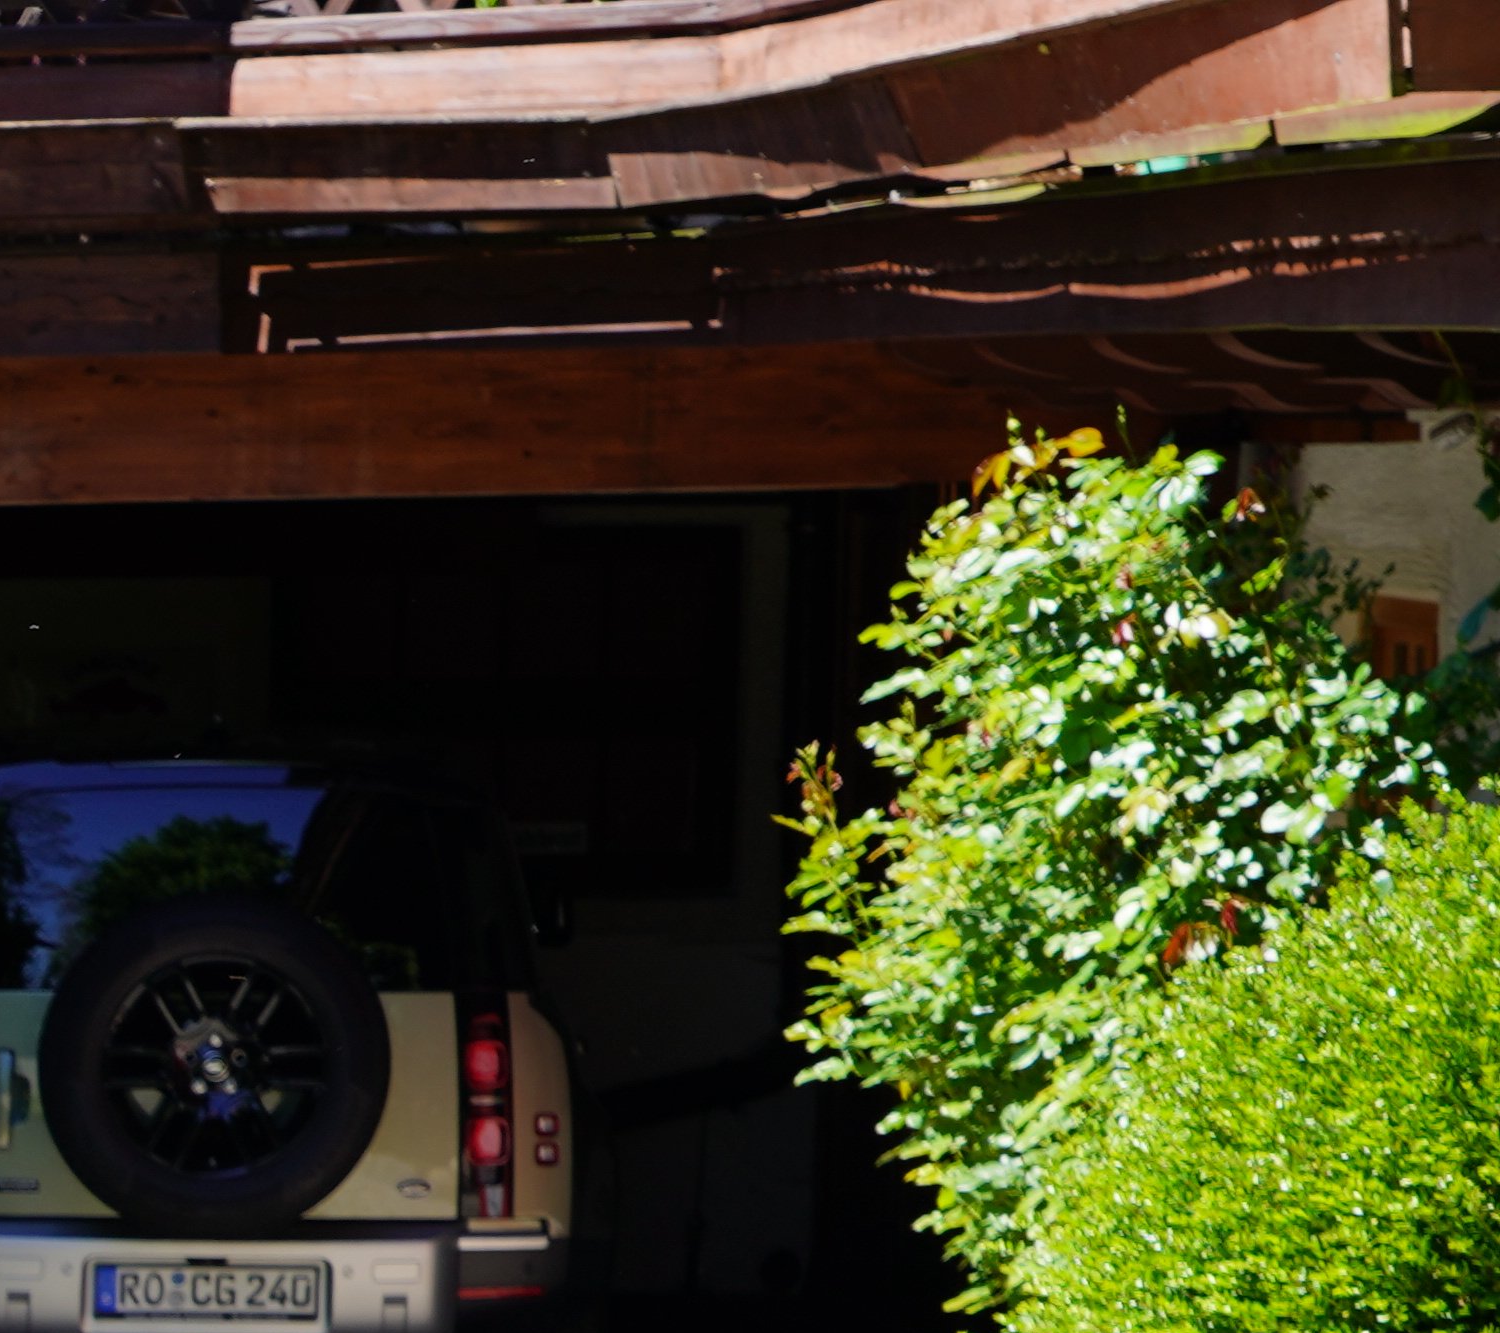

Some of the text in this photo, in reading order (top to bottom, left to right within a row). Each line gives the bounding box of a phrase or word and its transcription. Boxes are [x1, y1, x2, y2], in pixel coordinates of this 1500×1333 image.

[119, 1272, 312, 1306] RO CG 240
